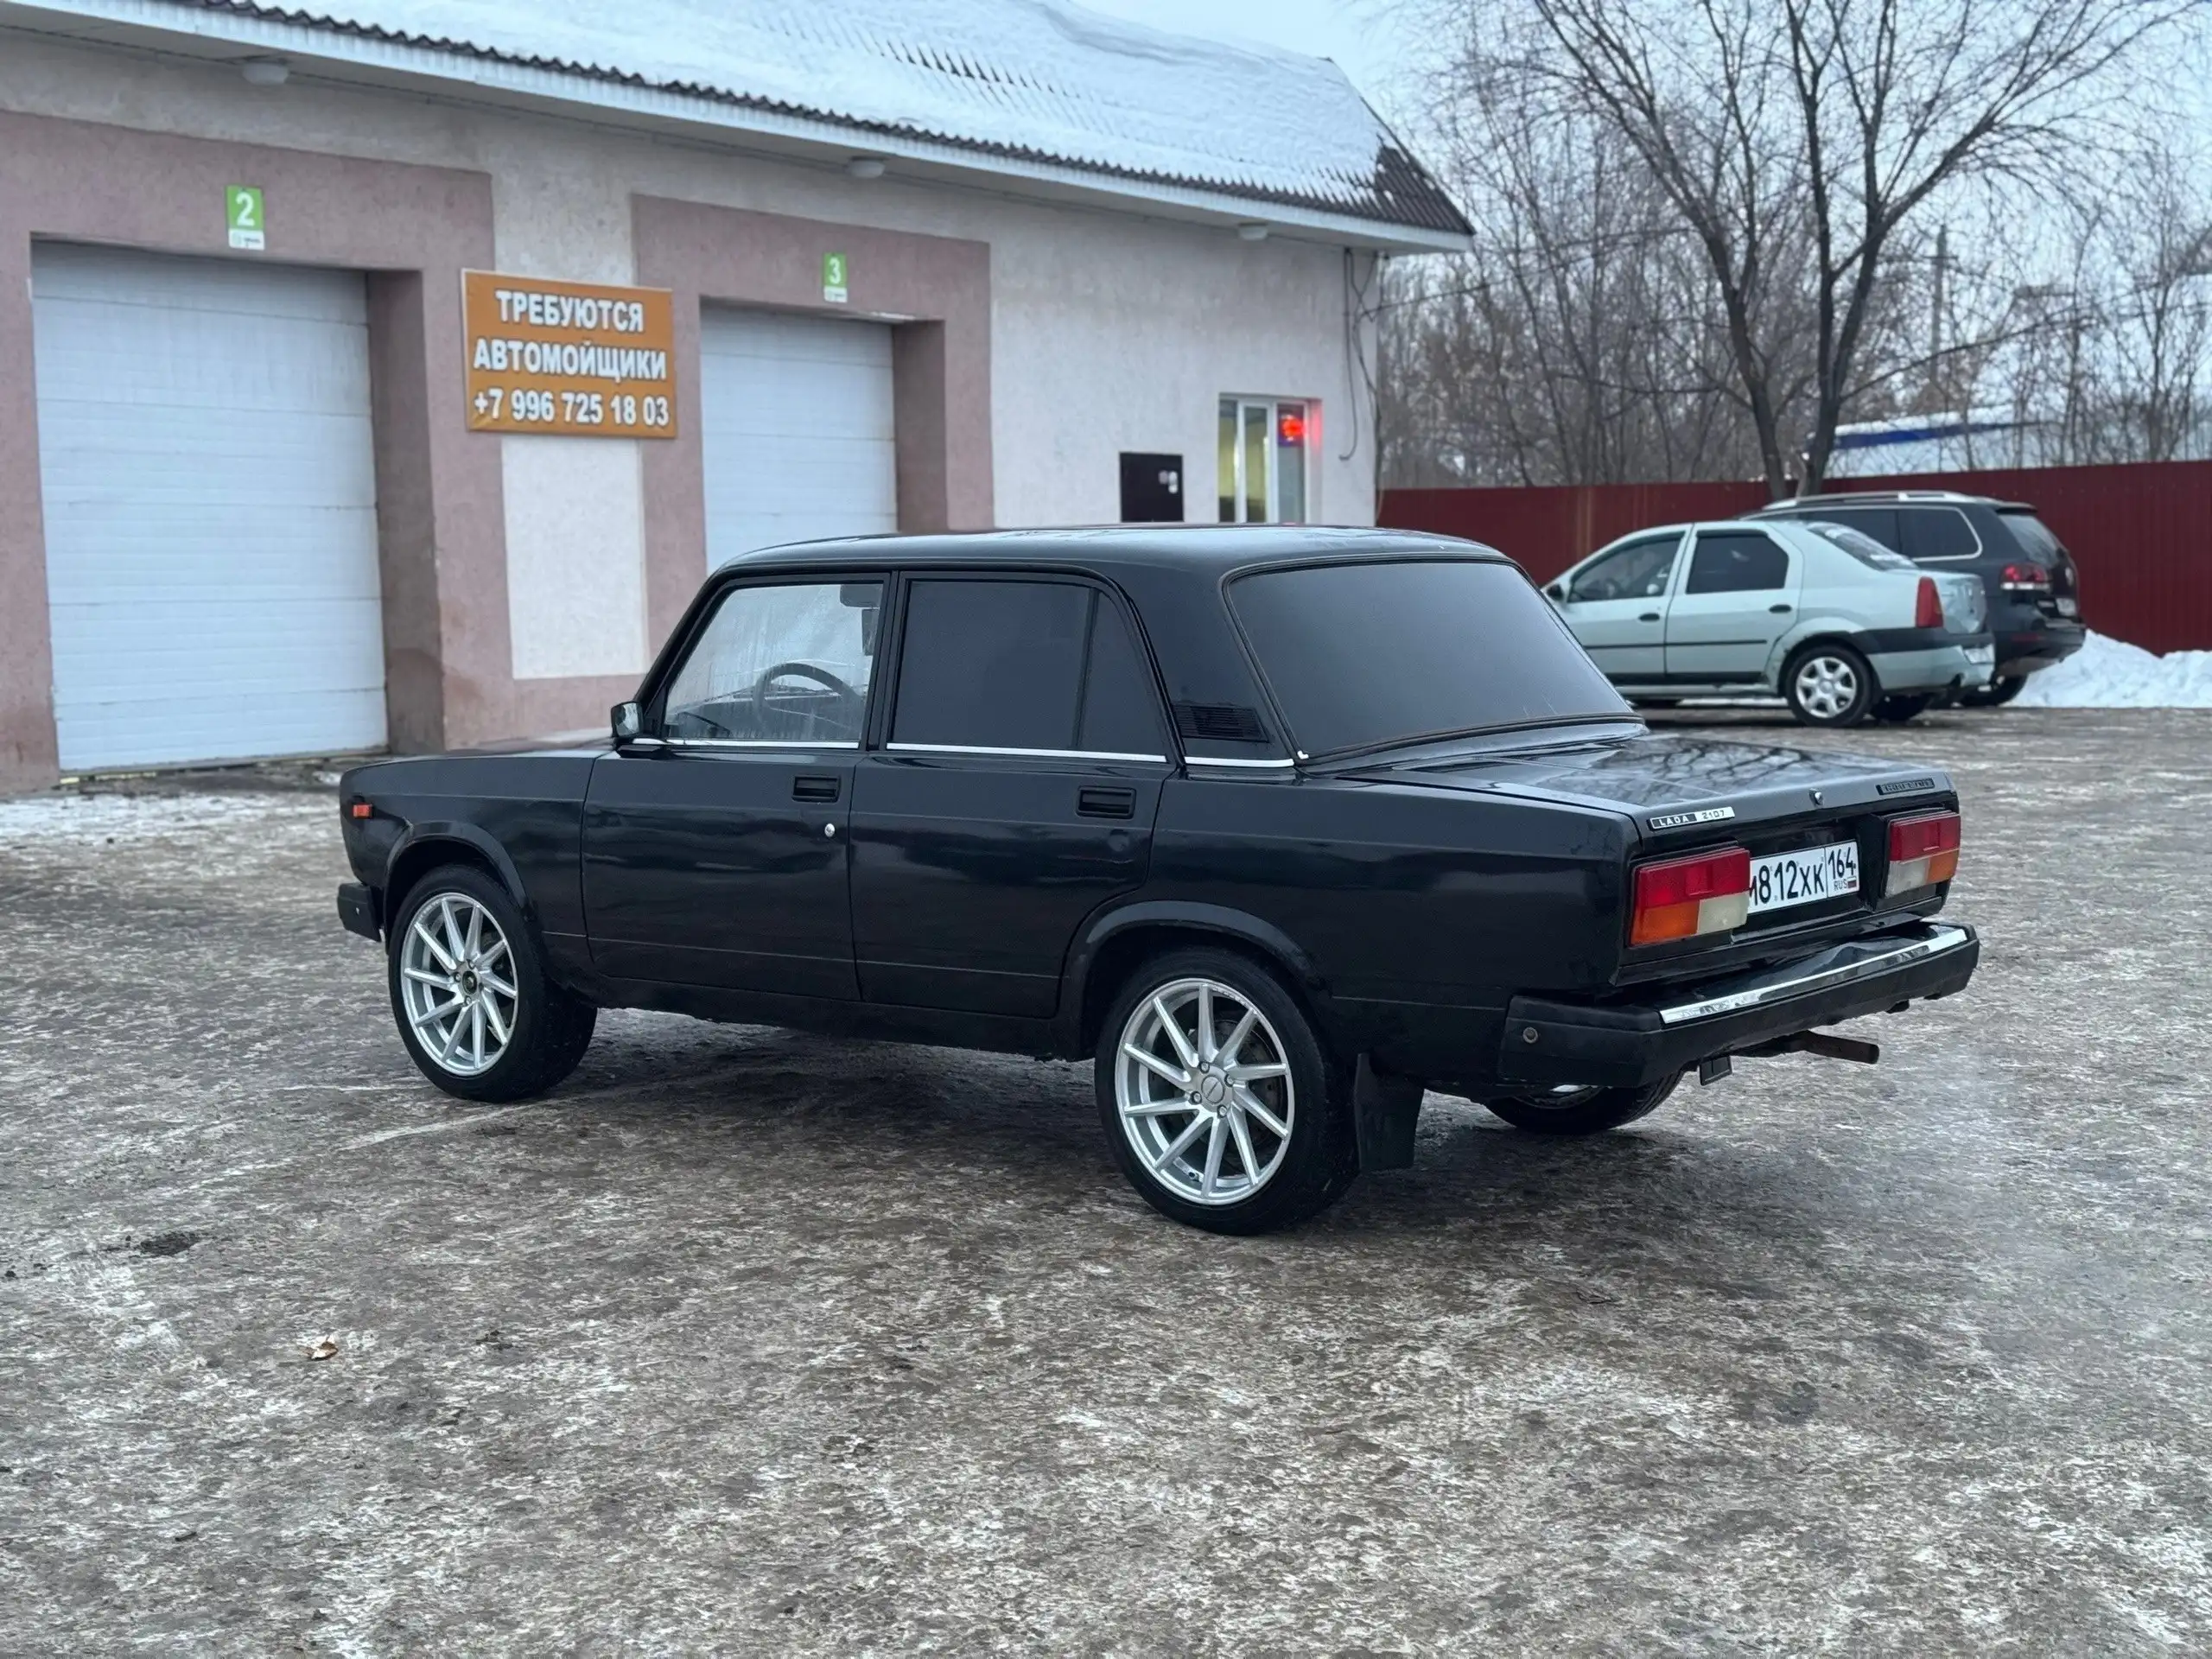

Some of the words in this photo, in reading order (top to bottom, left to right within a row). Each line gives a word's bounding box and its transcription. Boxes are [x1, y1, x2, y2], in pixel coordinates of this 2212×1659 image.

[235, 191, 255, 226] 2
[829, 257, 842, 284] 3
[495, 290, 644, 332] ТРЕБУЮТСЯ
[474, 339, 666, 383] АВТОМОЙЩИКИ
[475, 388, 503, 419] +7
[511, 390, 554, 422] 996
[562, 392, 603, 423] 725
[611, 394, 636, 424] 18
[643, 396, 670, 425] 03
[1659, 815, 1689, 826] LADA
[1701, 810, 1726, 820] 2107
[1827, 847, 1854, 880] 164
[1834, 878, 1847, 891] RUS
